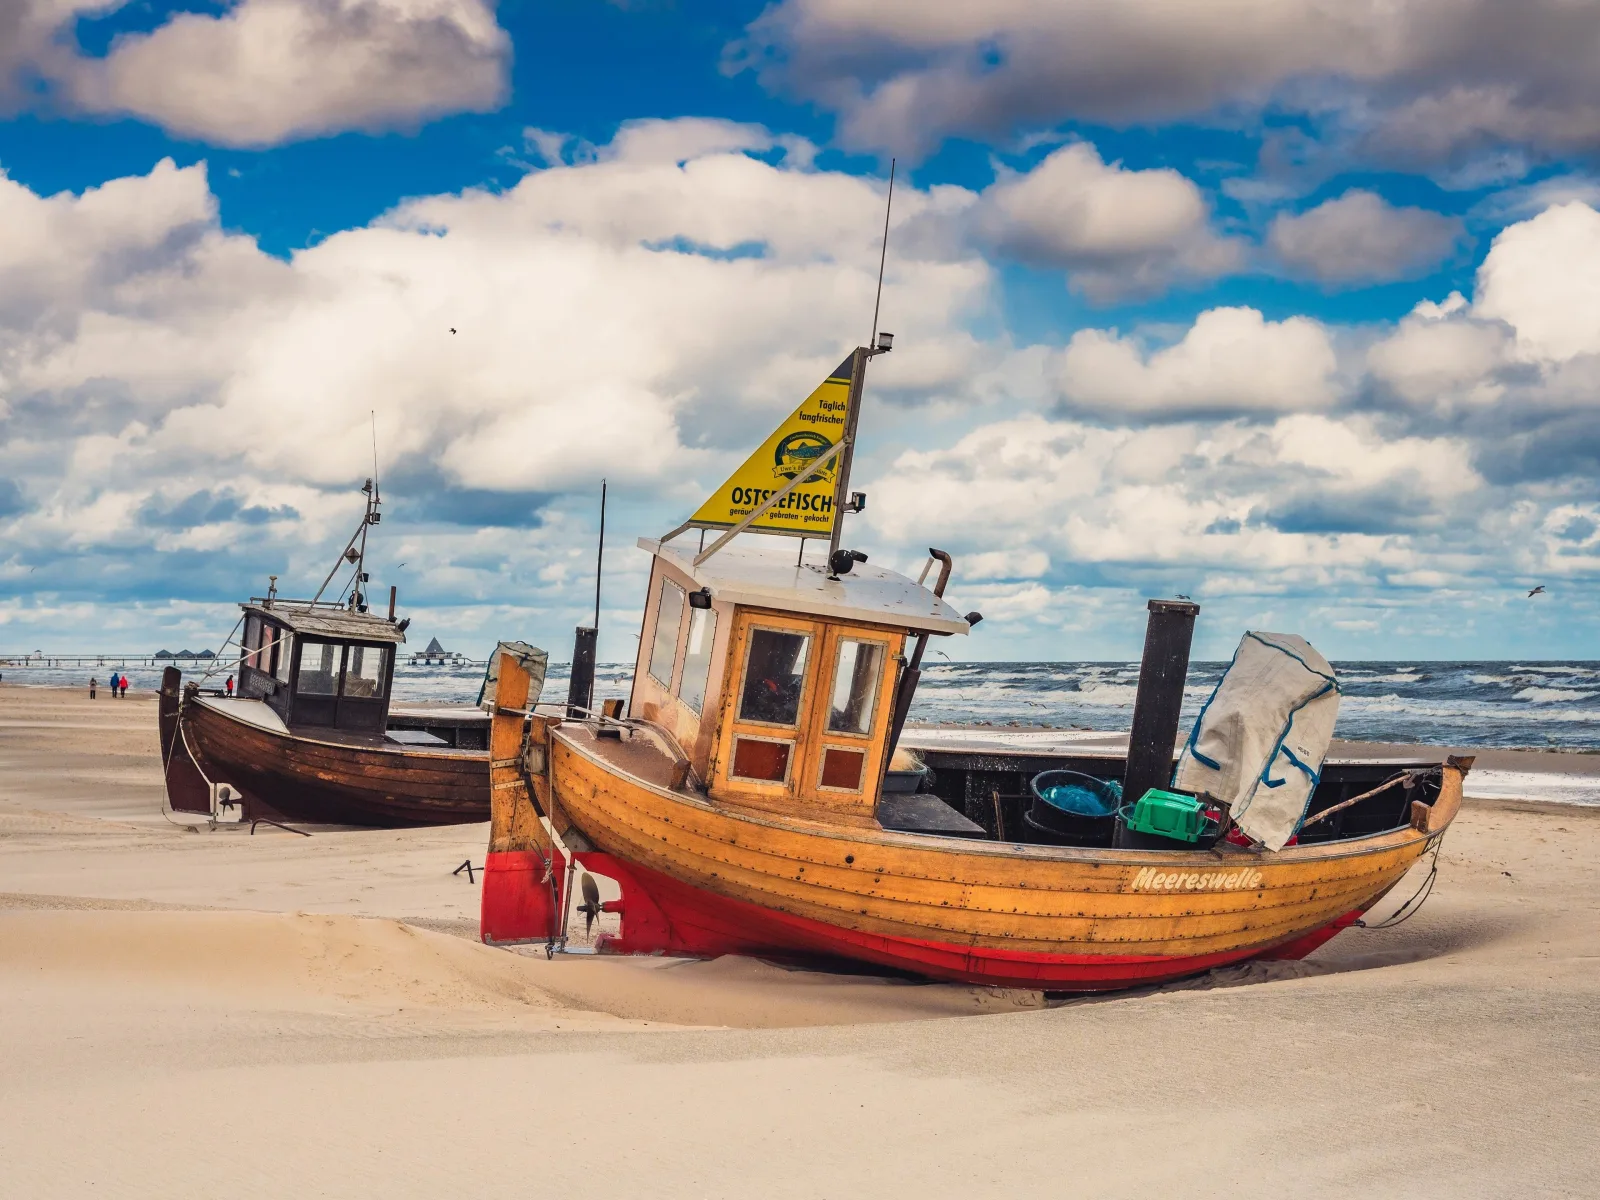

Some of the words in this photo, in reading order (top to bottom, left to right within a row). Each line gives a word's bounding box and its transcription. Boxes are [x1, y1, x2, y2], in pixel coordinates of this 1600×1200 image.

[819, 400, 846, 411] Täglich
[799, 411, 844, 424] fangfrischer
[769, 511, 799, 520] gebraten
[803, 514, 829, 523] gekocht
[1131, 867, 1262, 889] Meereswelle
